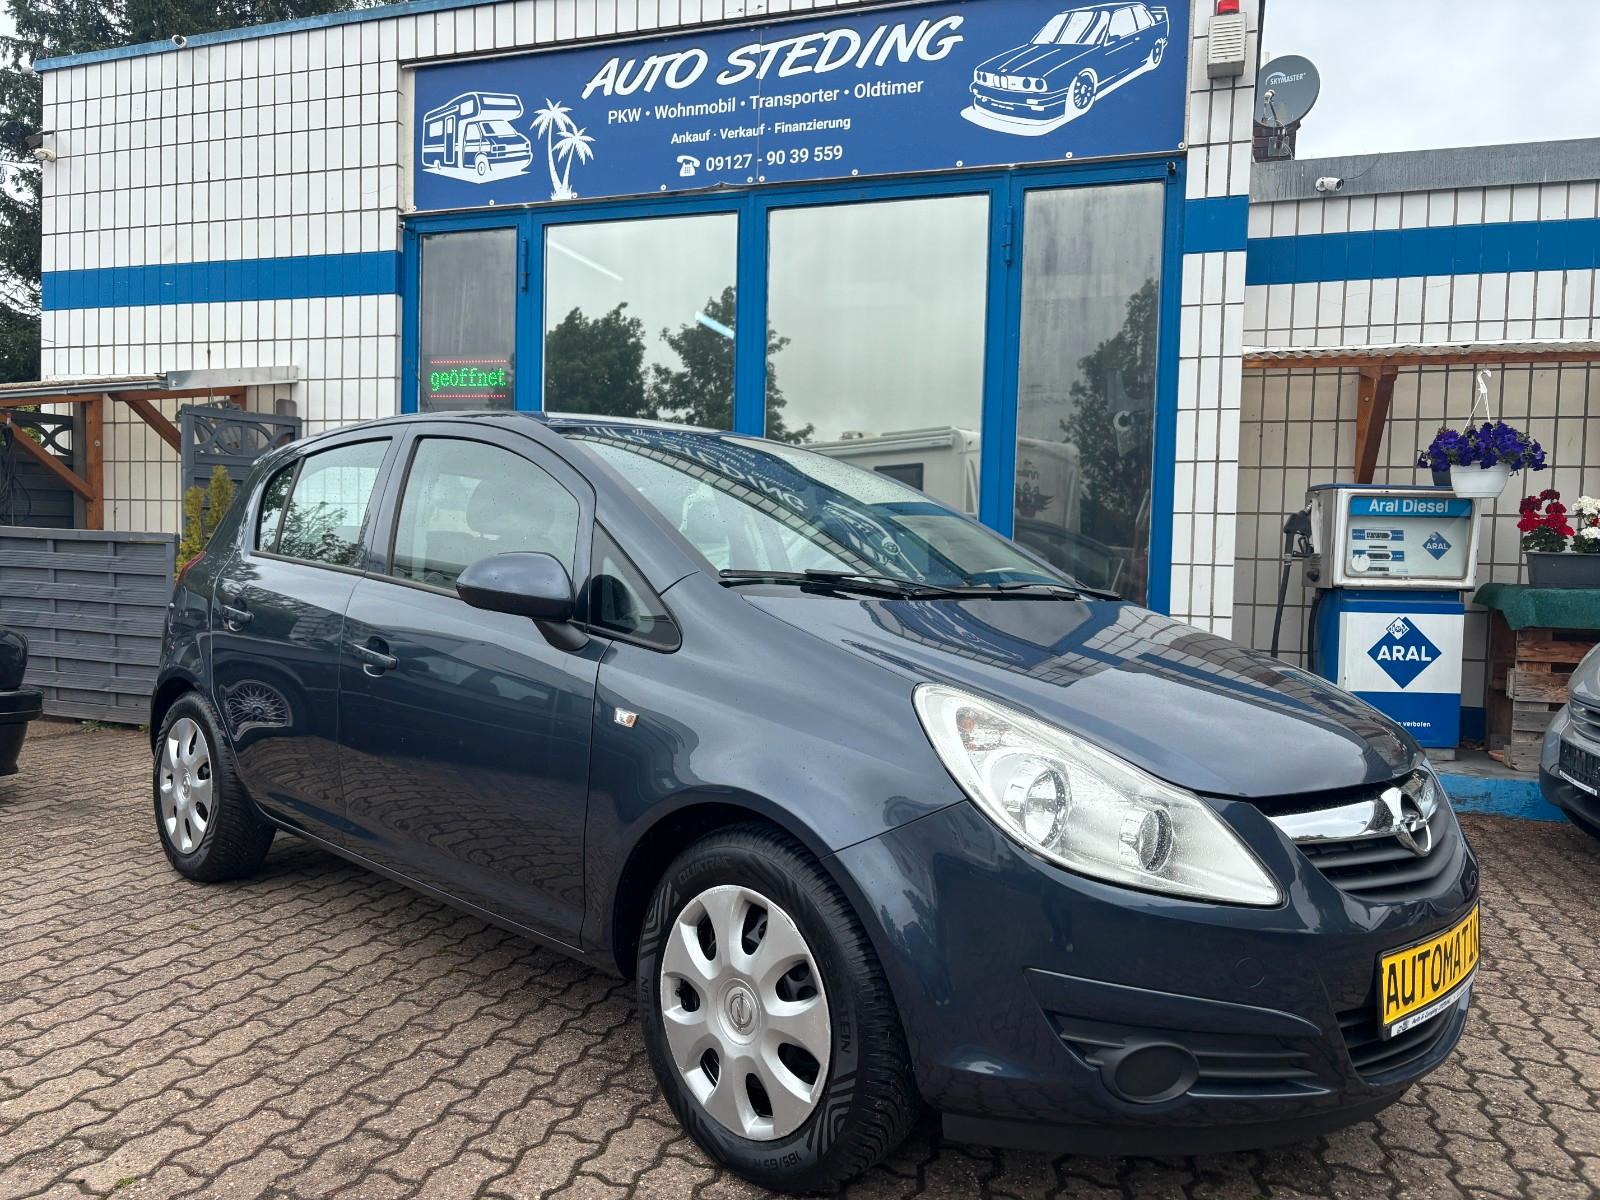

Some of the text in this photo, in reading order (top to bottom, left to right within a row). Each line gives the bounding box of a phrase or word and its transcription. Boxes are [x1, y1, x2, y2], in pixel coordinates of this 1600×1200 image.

[581, 15, 965, 100] AUTO STEDING
[607, 80, 924, 125] PKW Wohnmobil Transporter Oldtimer
[671, 117, 852, 145] Ankauf Verkauf Finanzierung
[705, 153, 752, 172] 09127
[766, 150, 786, 166] 90
[789, 148, 809, 164] 39
[813, 145, 844, 162] 559
[430, 367, 507, 392] geöffnet
[1369, 498, 1449, 513] Aral Diesel
[1426, 542, 1449, 550] ARAL
[1376, 645, 1432, 661] ARAL
[1386, 911, 1479, 1016] AUTOMATIK
